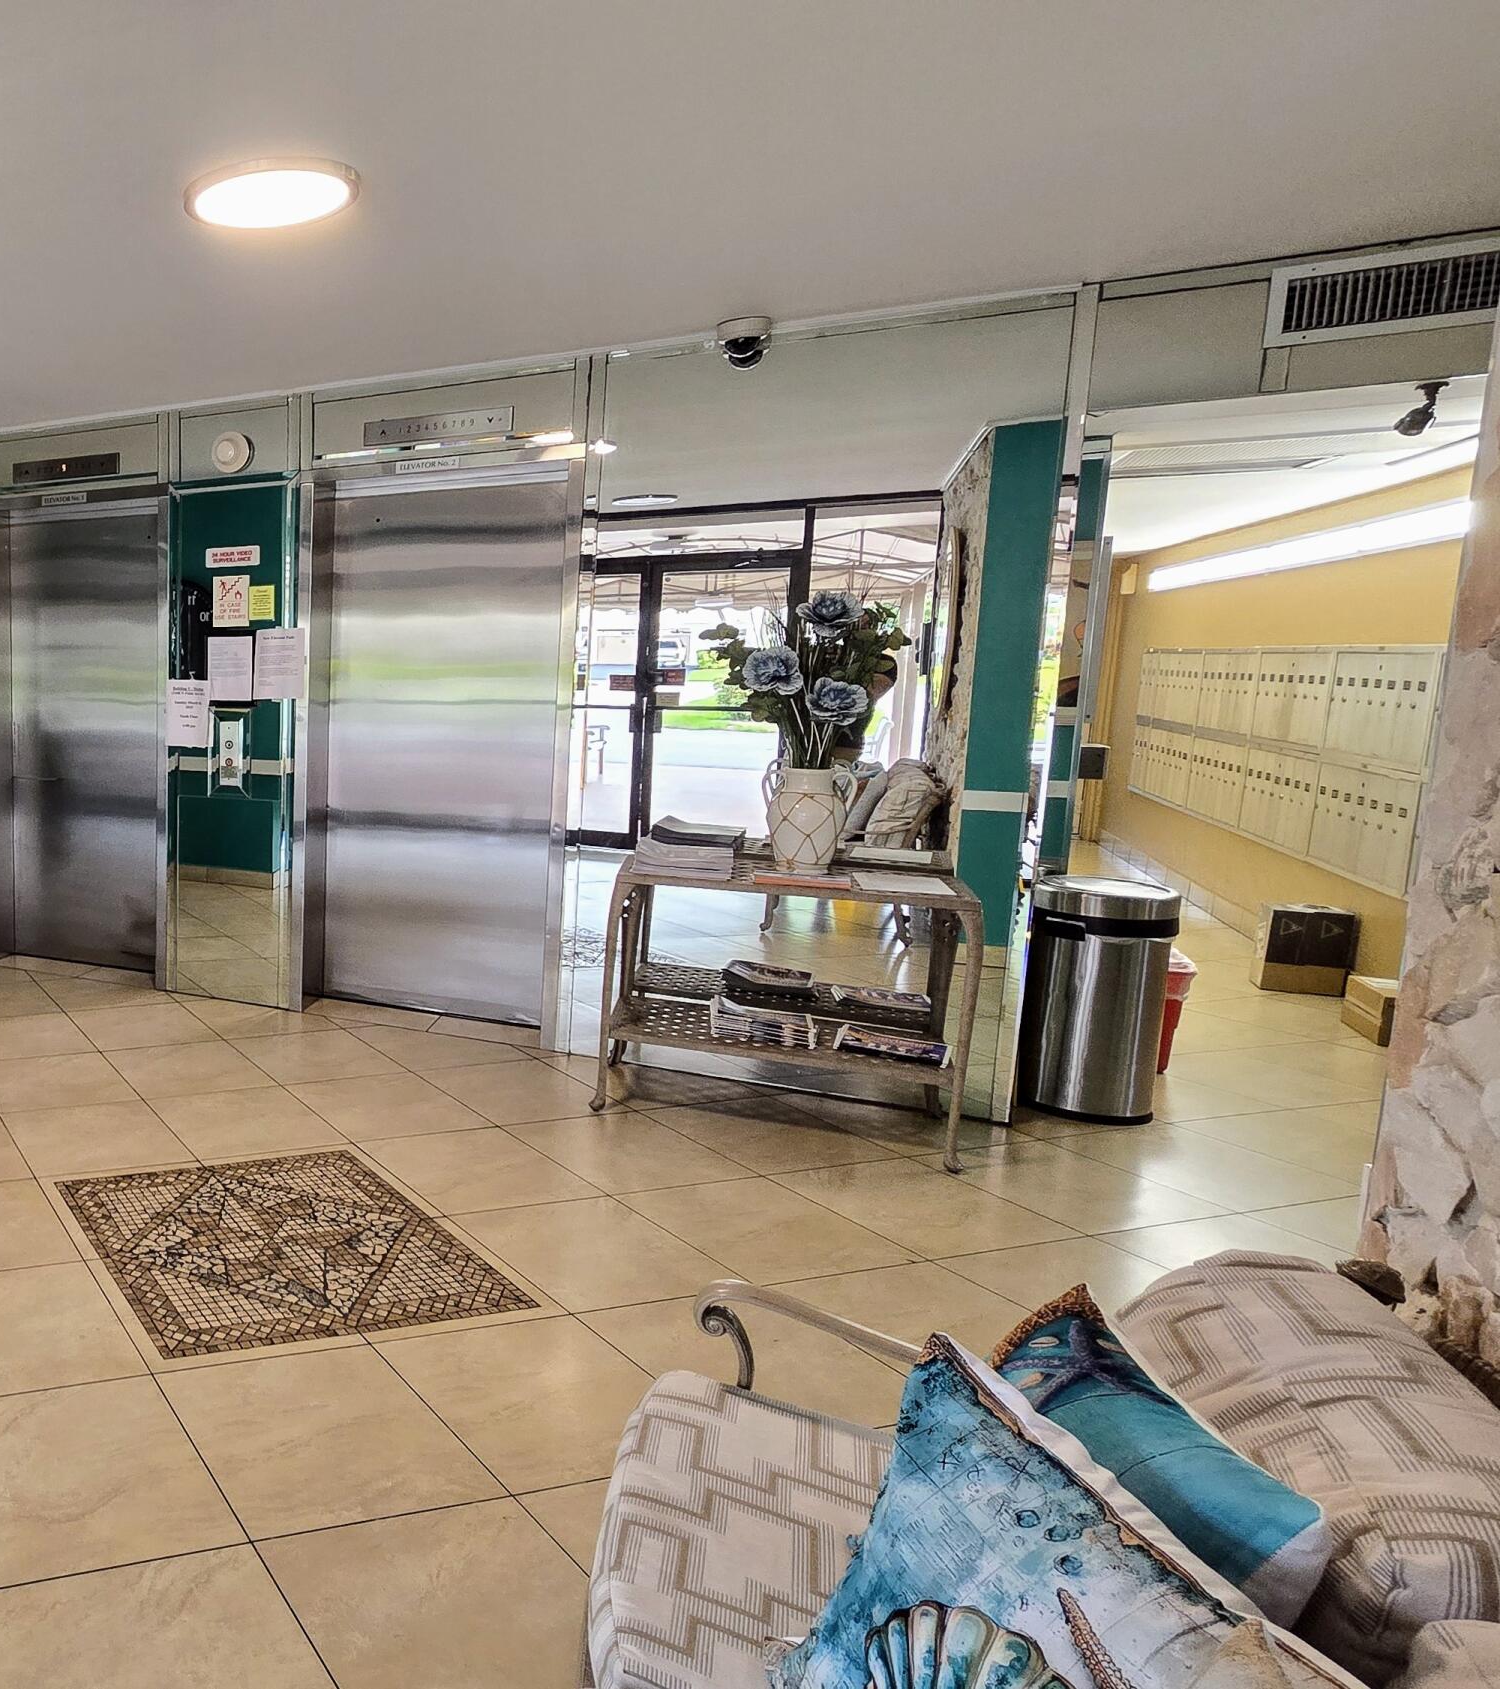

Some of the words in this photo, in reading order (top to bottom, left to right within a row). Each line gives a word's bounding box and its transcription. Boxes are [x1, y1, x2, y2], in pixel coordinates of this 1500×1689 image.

[406, 425, 412, 433] 2
[415, 424, 421, 433] 3
[433, 422, 438, 430] 5
[400, 461, 436, 471] ELEVATOR
[44, 496, 70, 504] ELEVATOR
